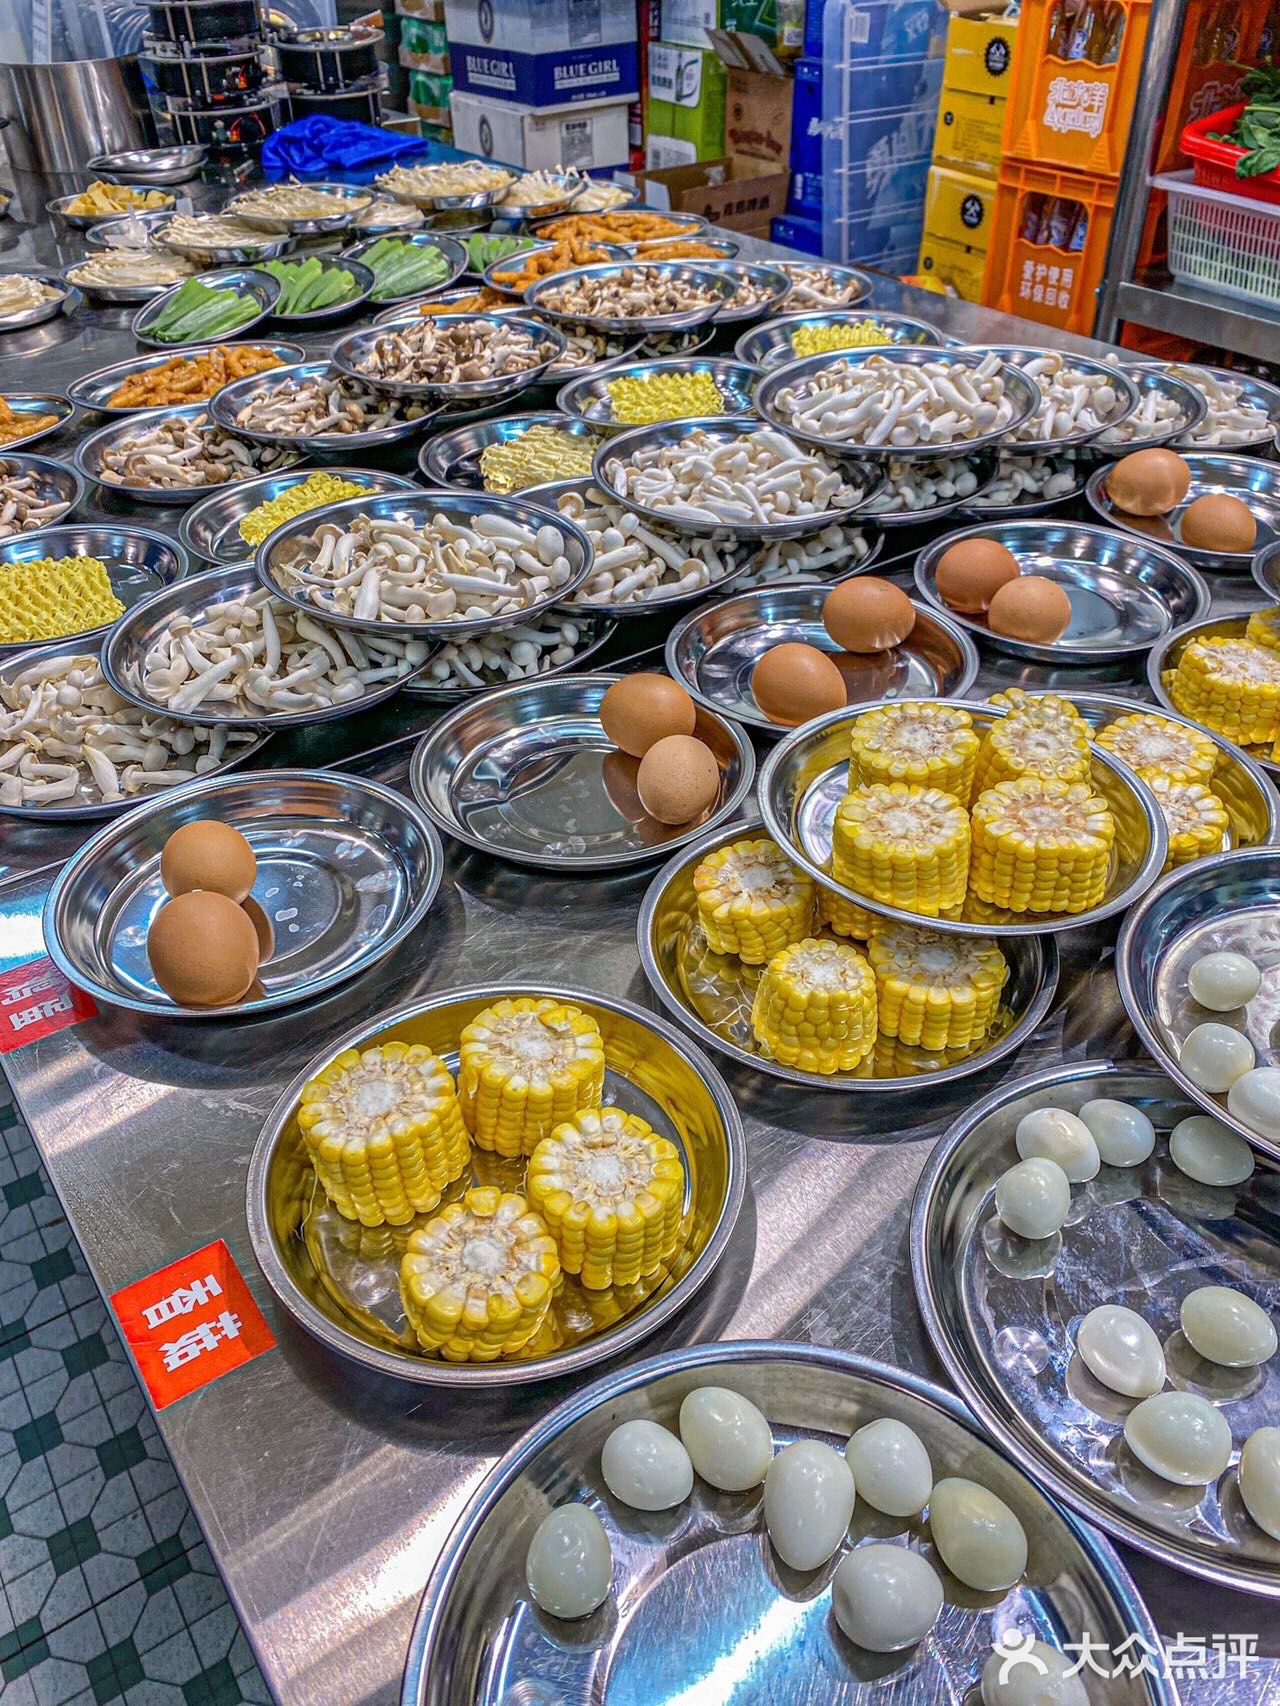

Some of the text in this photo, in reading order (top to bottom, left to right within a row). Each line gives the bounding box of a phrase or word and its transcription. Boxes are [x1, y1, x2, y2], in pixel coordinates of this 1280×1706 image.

[466, 55, 516, 78] BLUE GIRL
[554, 59, 620, 80] BLUE GIRL
[142, 1273, 243, 1373] 香菇
